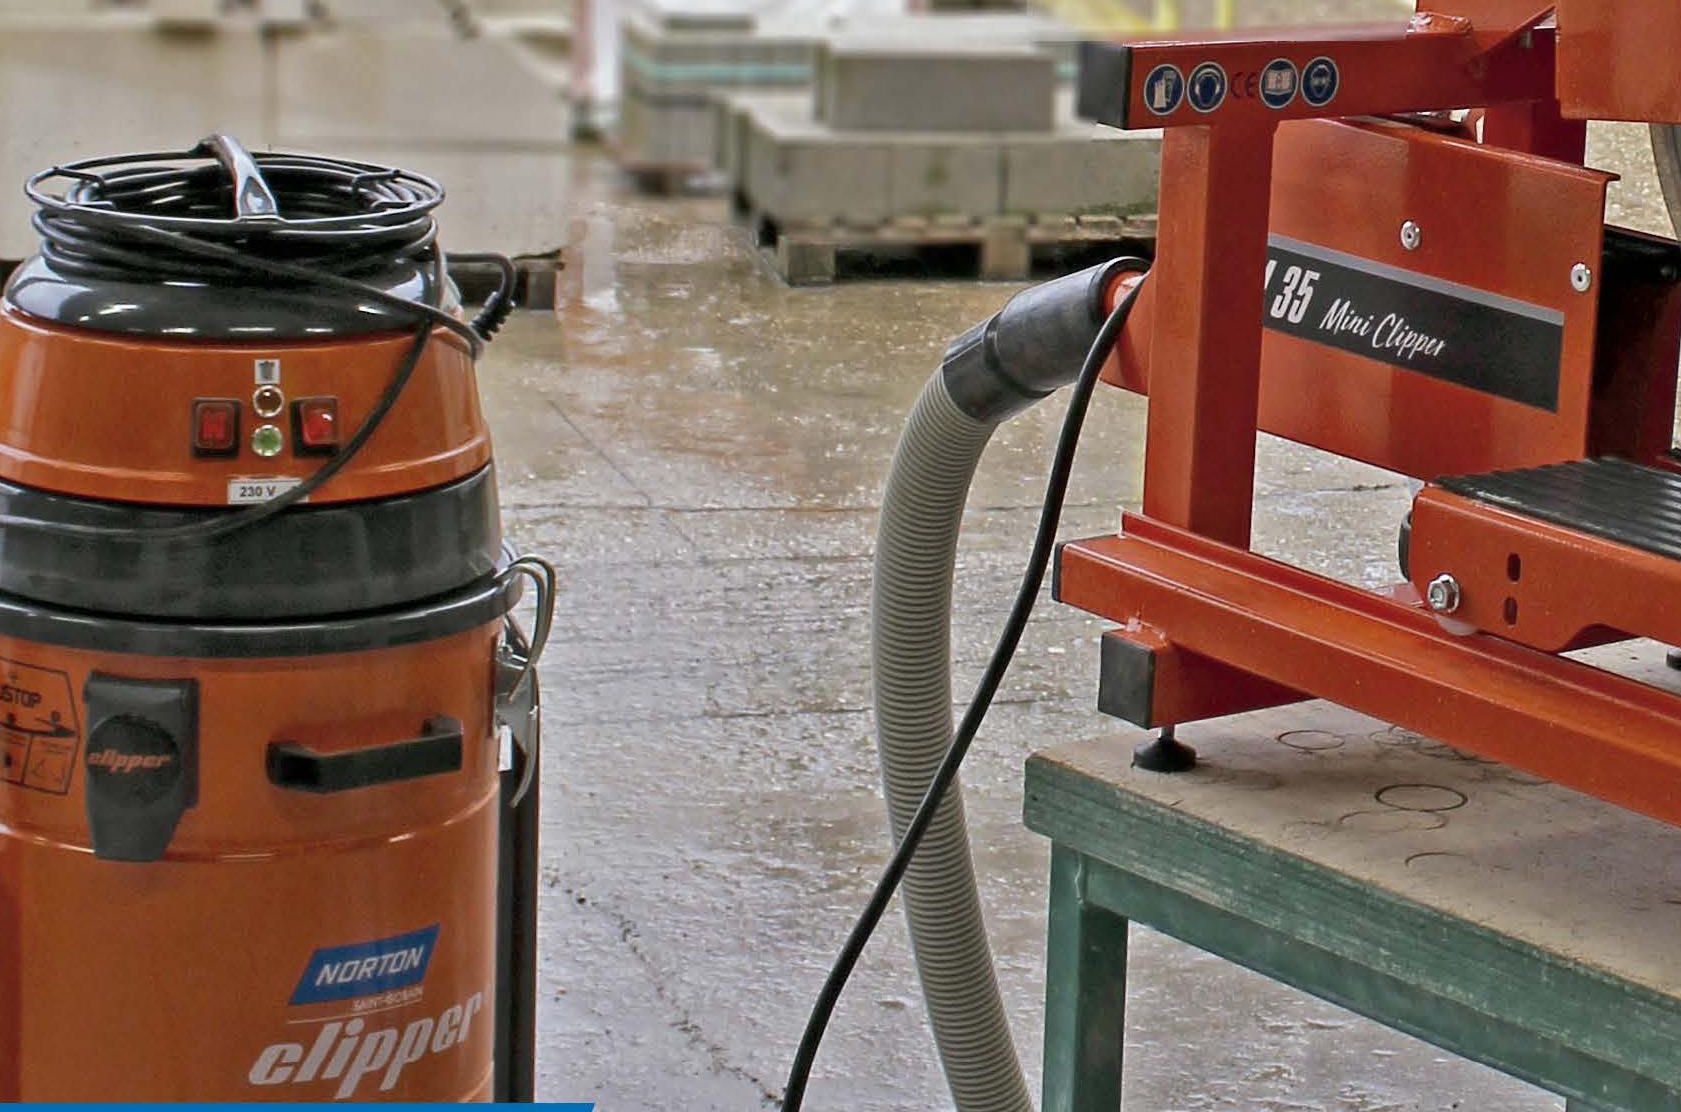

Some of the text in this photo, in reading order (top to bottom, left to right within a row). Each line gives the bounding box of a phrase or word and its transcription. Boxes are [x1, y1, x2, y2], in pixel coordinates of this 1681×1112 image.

[1270, 266, 1321, 324] 35
[1319, 298, 1374, 337] Mini
[1371, 313, 1446, 360] Clipper
[240, 486, 276, 497] 230 V
[315, 945, 425, 986] NORTON
[249, 992, 482, 1099] clipper
